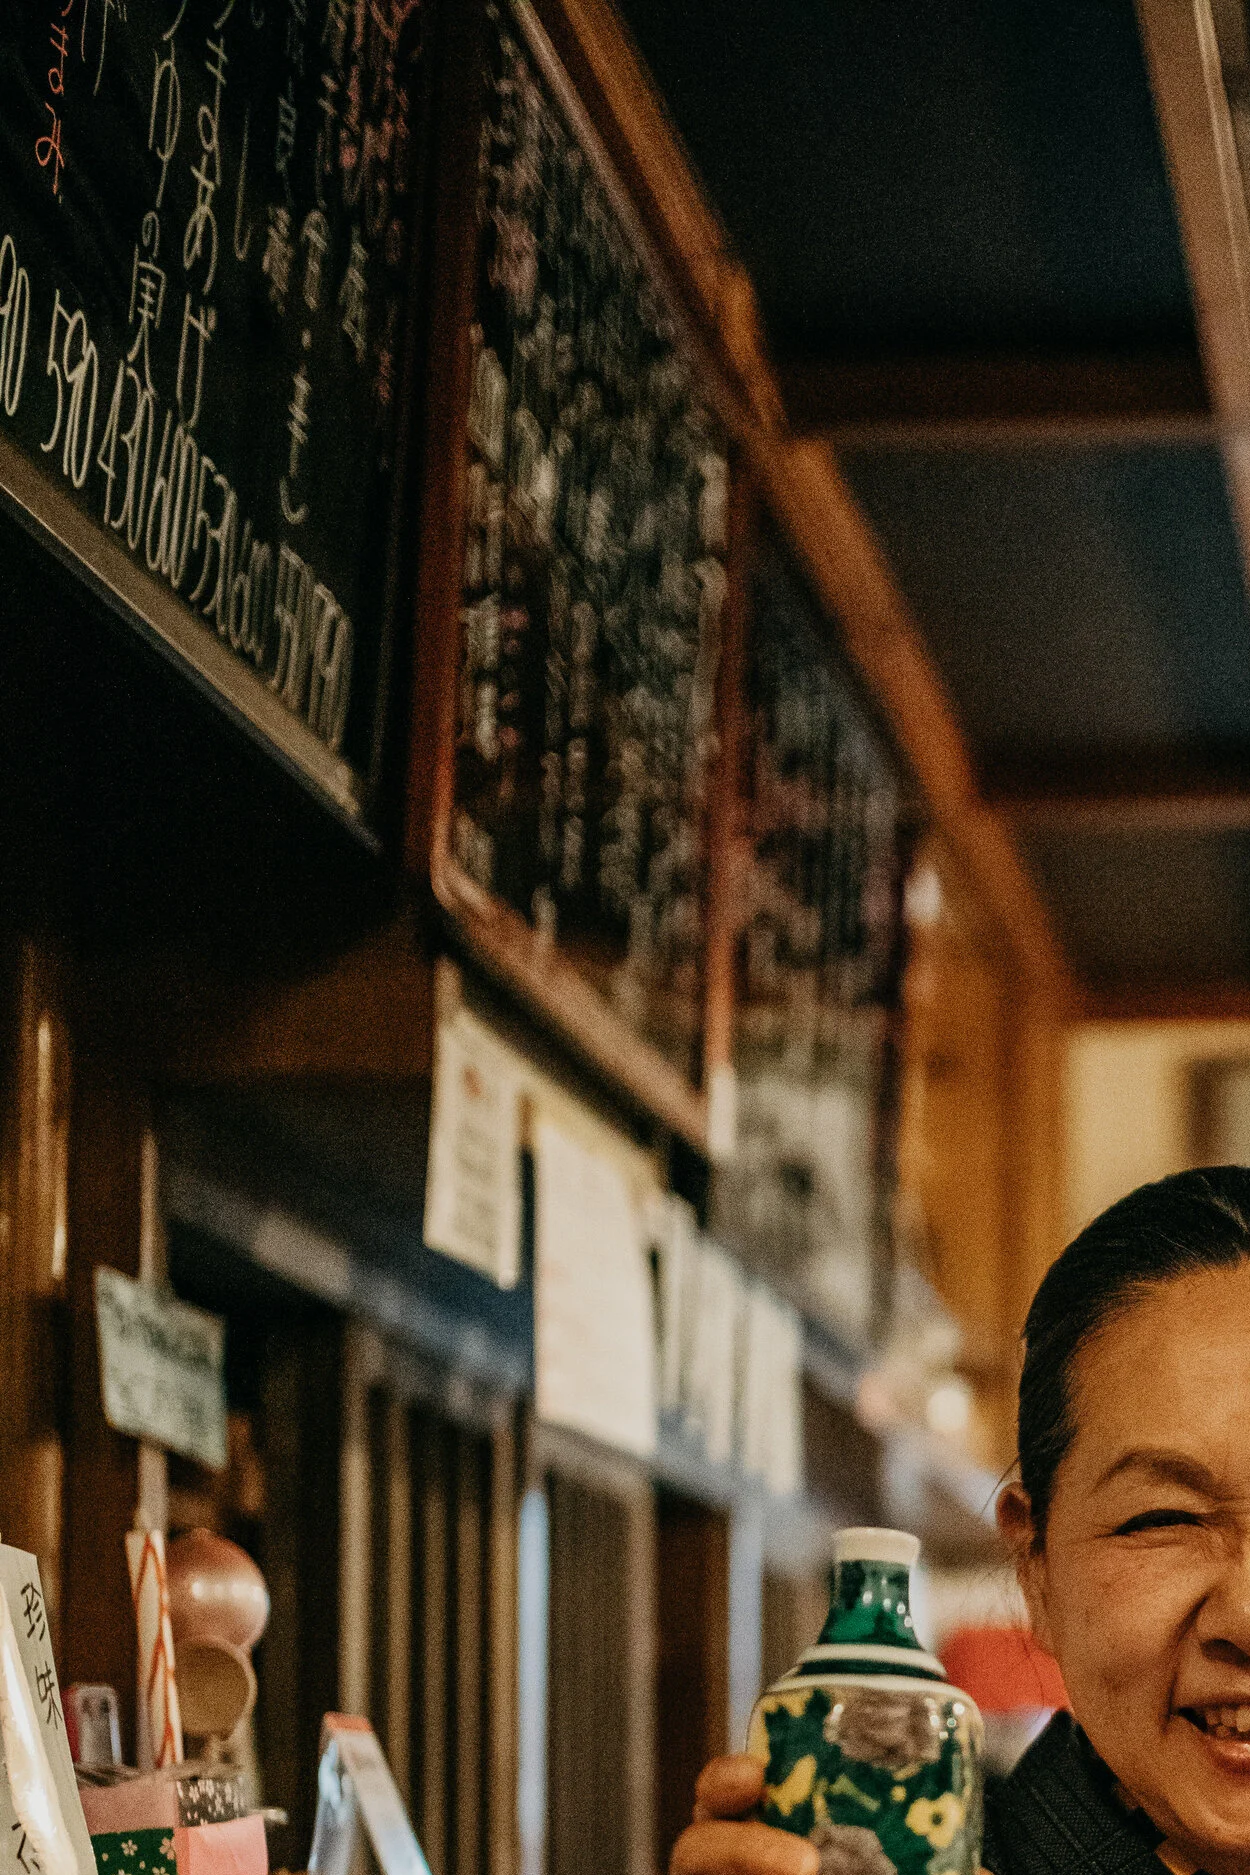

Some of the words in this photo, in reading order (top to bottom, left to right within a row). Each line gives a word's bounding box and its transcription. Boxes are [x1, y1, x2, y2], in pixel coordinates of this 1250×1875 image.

[36, 0, 75, 195] まみ
[40, 288, 99, 488] 590
[96, 358, 155, 550] 430
[20, 1580, 64, 1730] 珍味
